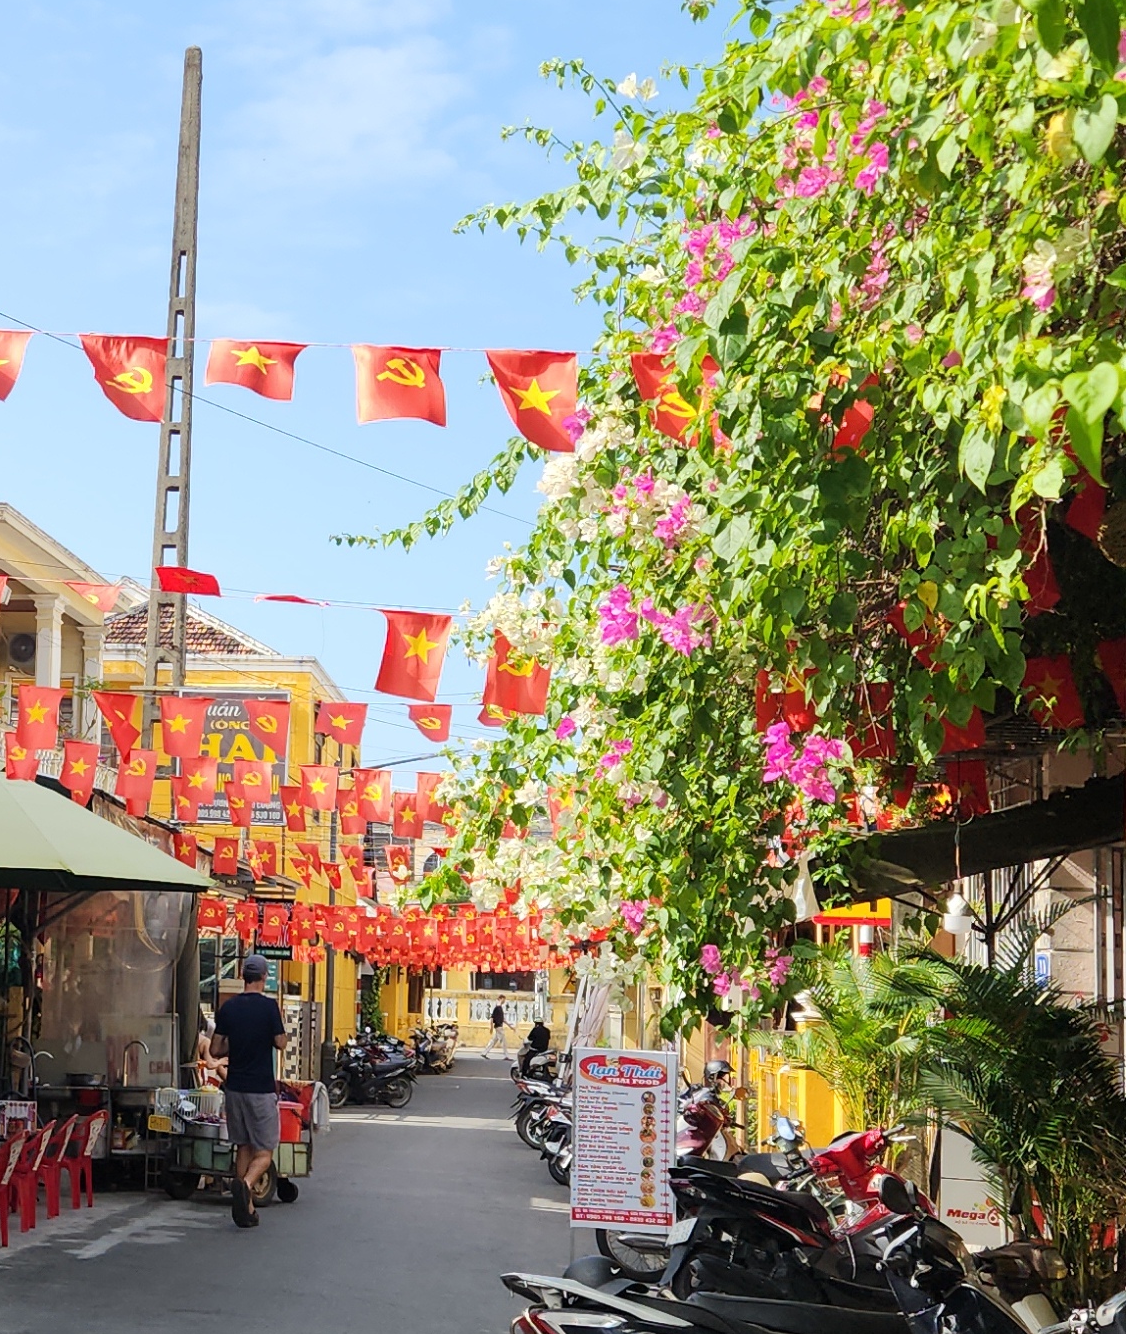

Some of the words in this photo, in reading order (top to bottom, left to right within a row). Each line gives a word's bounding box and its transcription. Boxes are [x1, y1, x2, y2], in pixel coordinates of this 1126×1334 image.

[207, 701, 242, 717] uán
[588, 1063, 619, 1078] Lan
[621, 1064, 664, 1079] Thái
[946, 1208, 986, 1221] Mega
